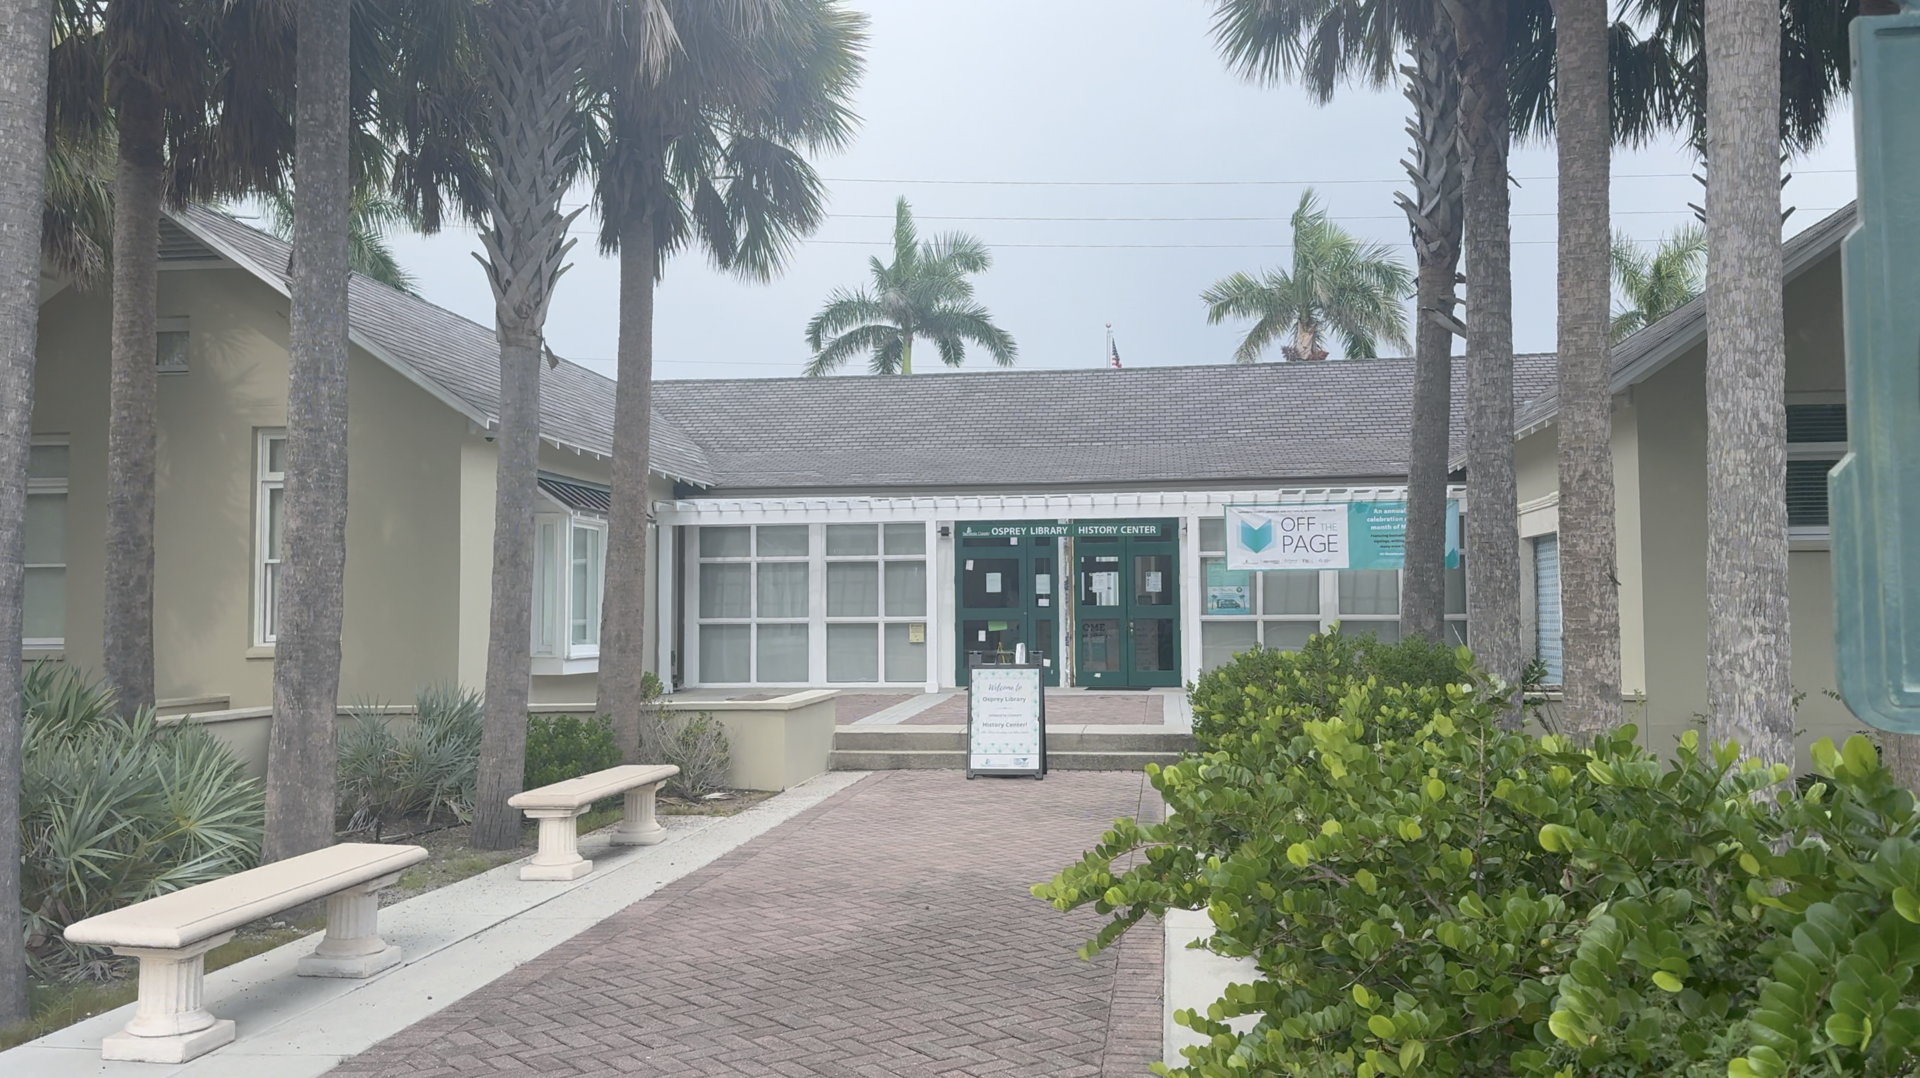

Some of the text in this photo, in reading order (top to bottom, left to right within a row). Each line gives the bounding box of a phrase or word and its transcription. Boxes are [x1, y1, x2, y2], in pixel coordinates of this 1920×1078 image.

[1281, 516, 1338, 532] OFF THE
[991, 526, 1068, 536] OSPREY LIBRARY
[1078, 525, 1156, 534] HISTORY CENTER
[1282, 534, 1338, 553] PAGE
[988, 682, 1022, 692] Welcome to
